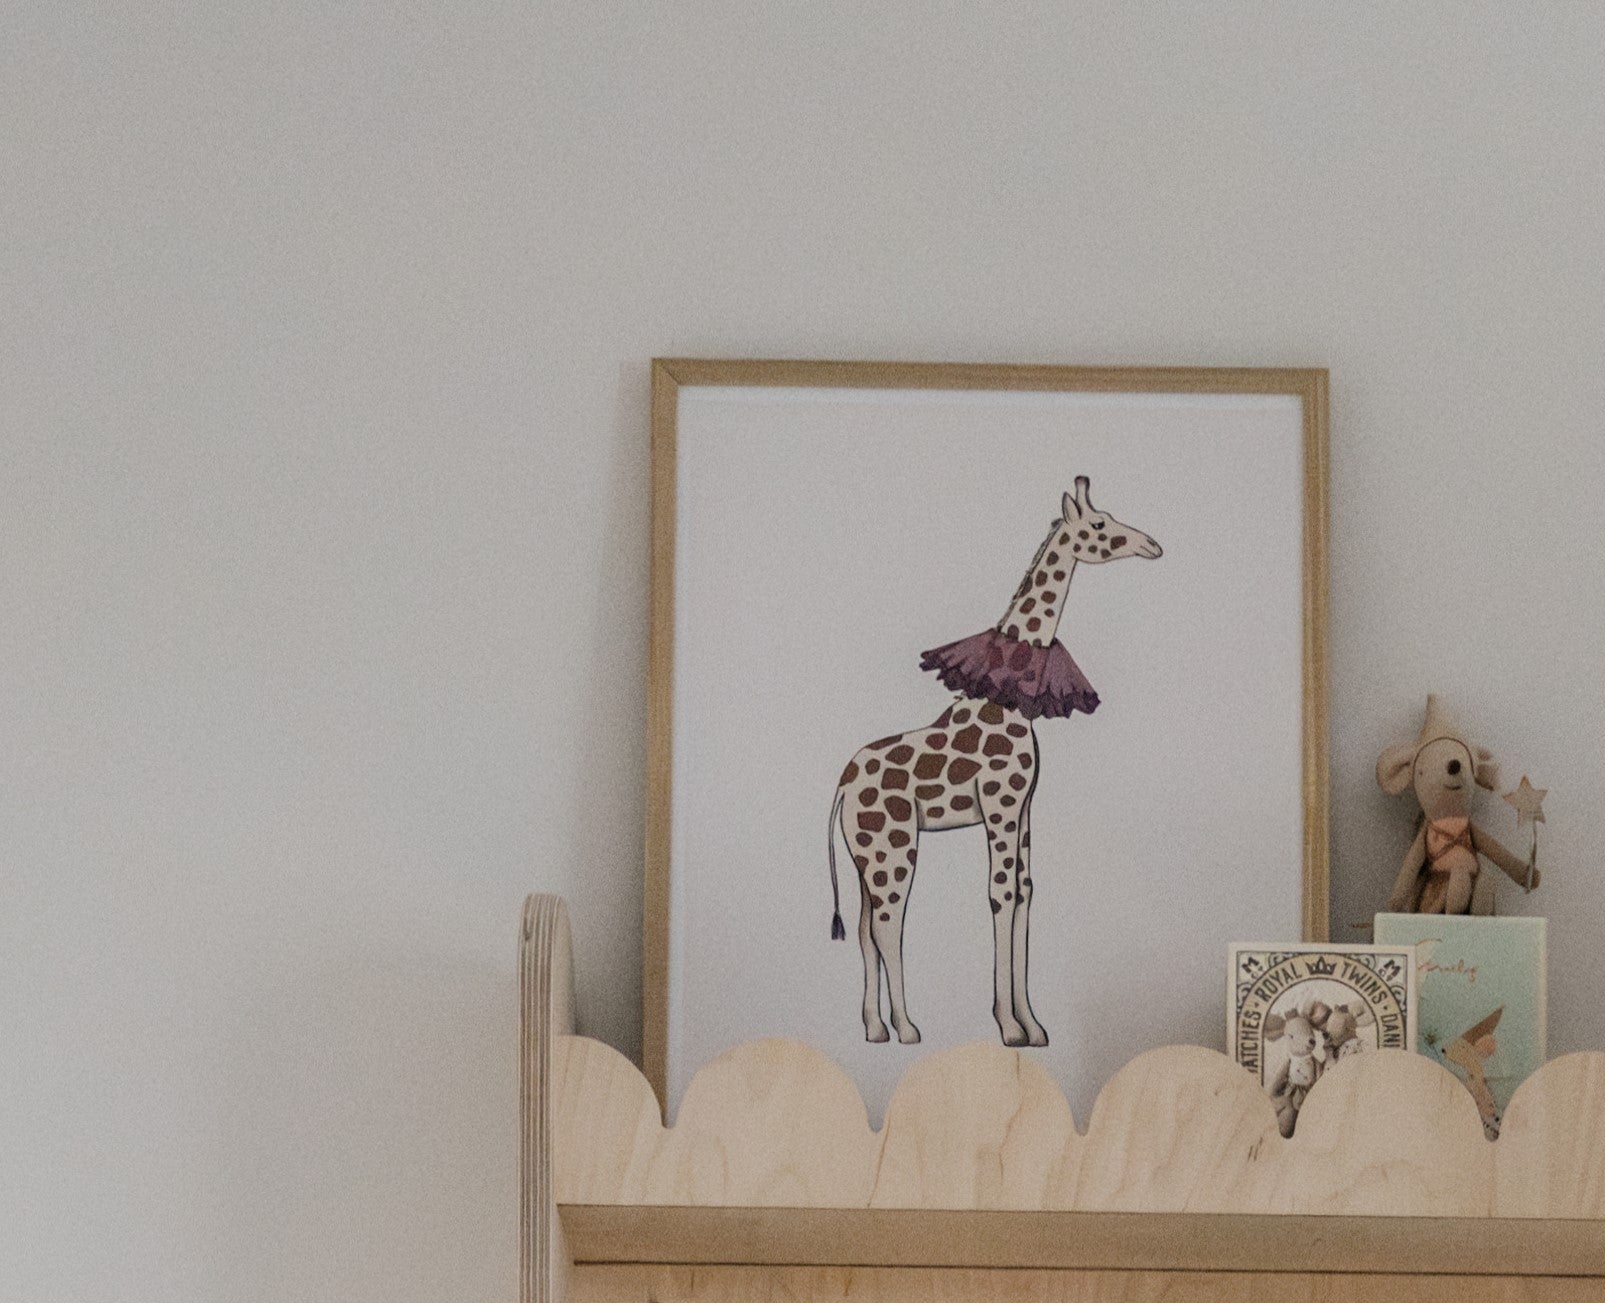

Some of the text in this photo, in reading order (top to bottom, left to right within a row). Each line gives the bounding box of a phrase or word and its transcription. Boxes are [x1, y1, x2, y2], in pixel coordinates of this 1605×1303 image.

[1240, 1010, 1262, 1074] ATCHES
[1254, 962, 1303, 1004] ROYAL
[1340, 961, 1390, 1005] TWINS
